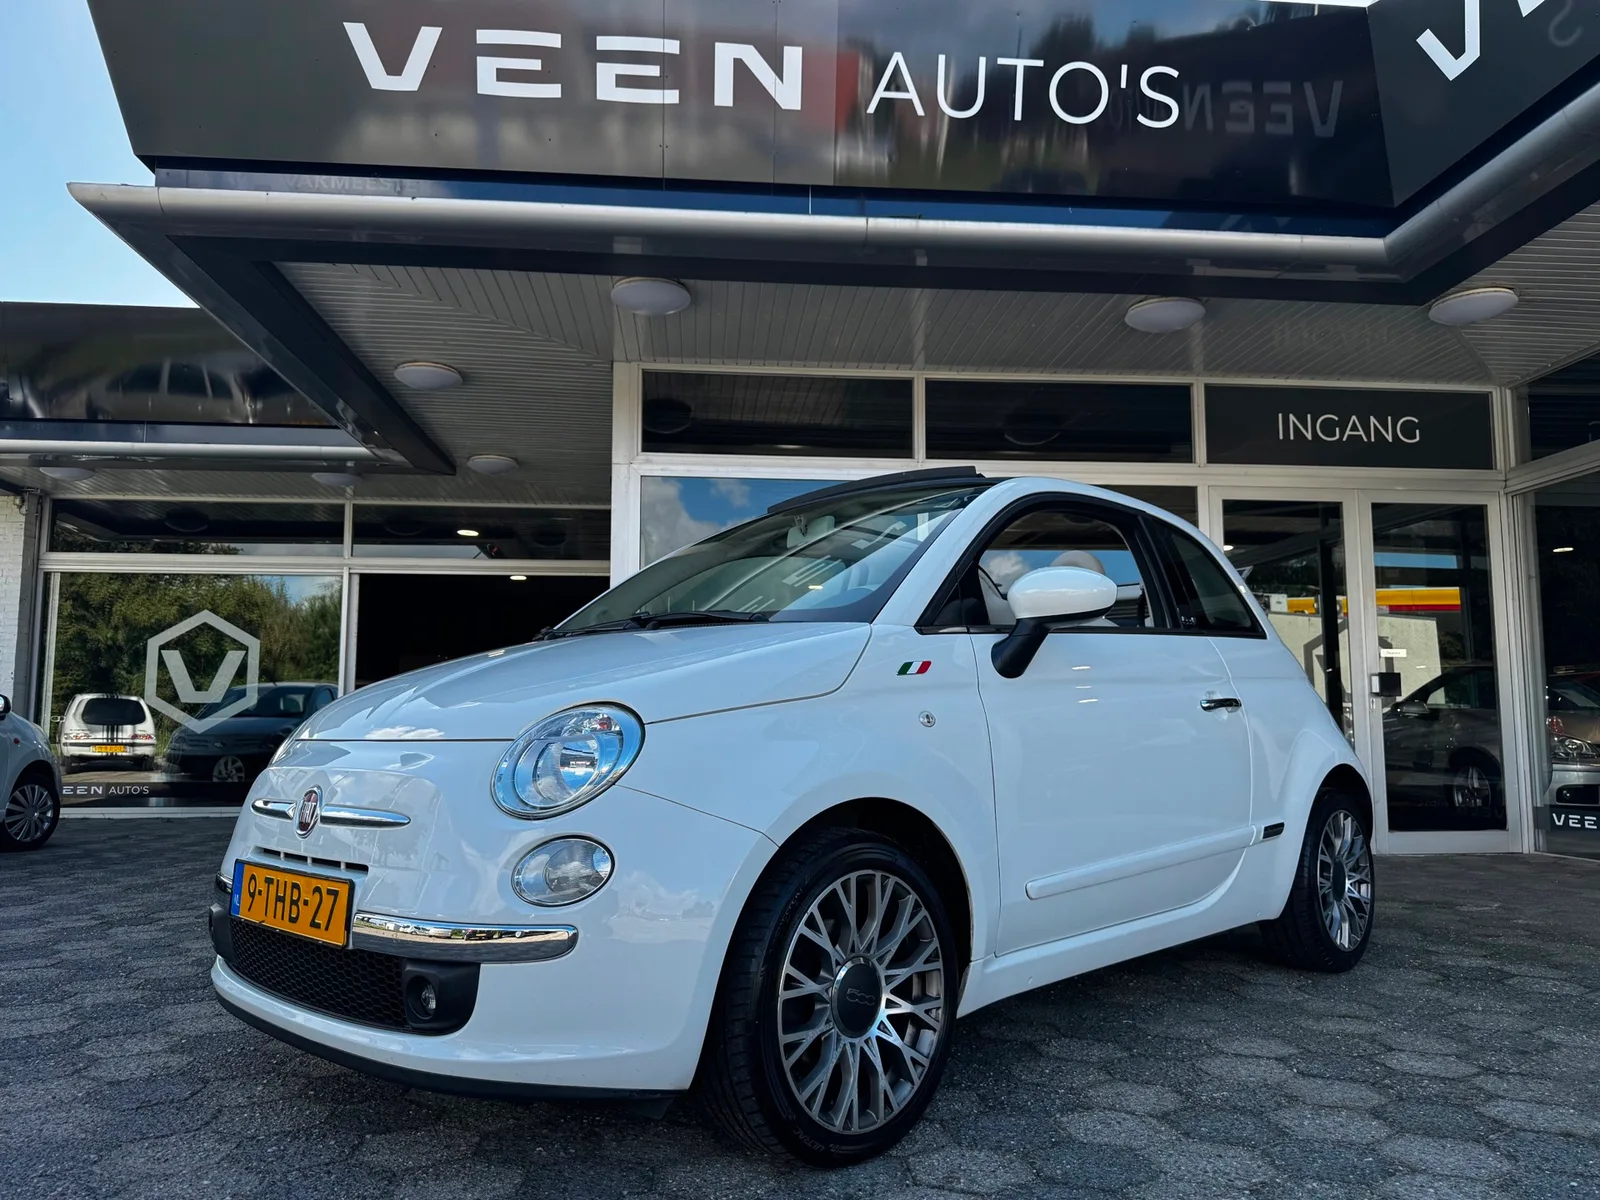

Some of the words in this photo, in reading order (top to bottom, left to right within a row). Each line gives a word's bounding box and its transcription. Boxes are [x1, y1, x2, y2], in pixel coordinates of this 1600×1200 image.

[343, 21, 803, 111] VEEN
[866, 51, 1181, 129] AUTO'S
[1277, 412, 1421, 444] INGANG
[62, 785, 103, 795] EEN
[108, 785, 150, 795] AUTO'S
[1551, 812, 1598, 830] VEE
[247, 872, 340, 932] 9-THB-27
